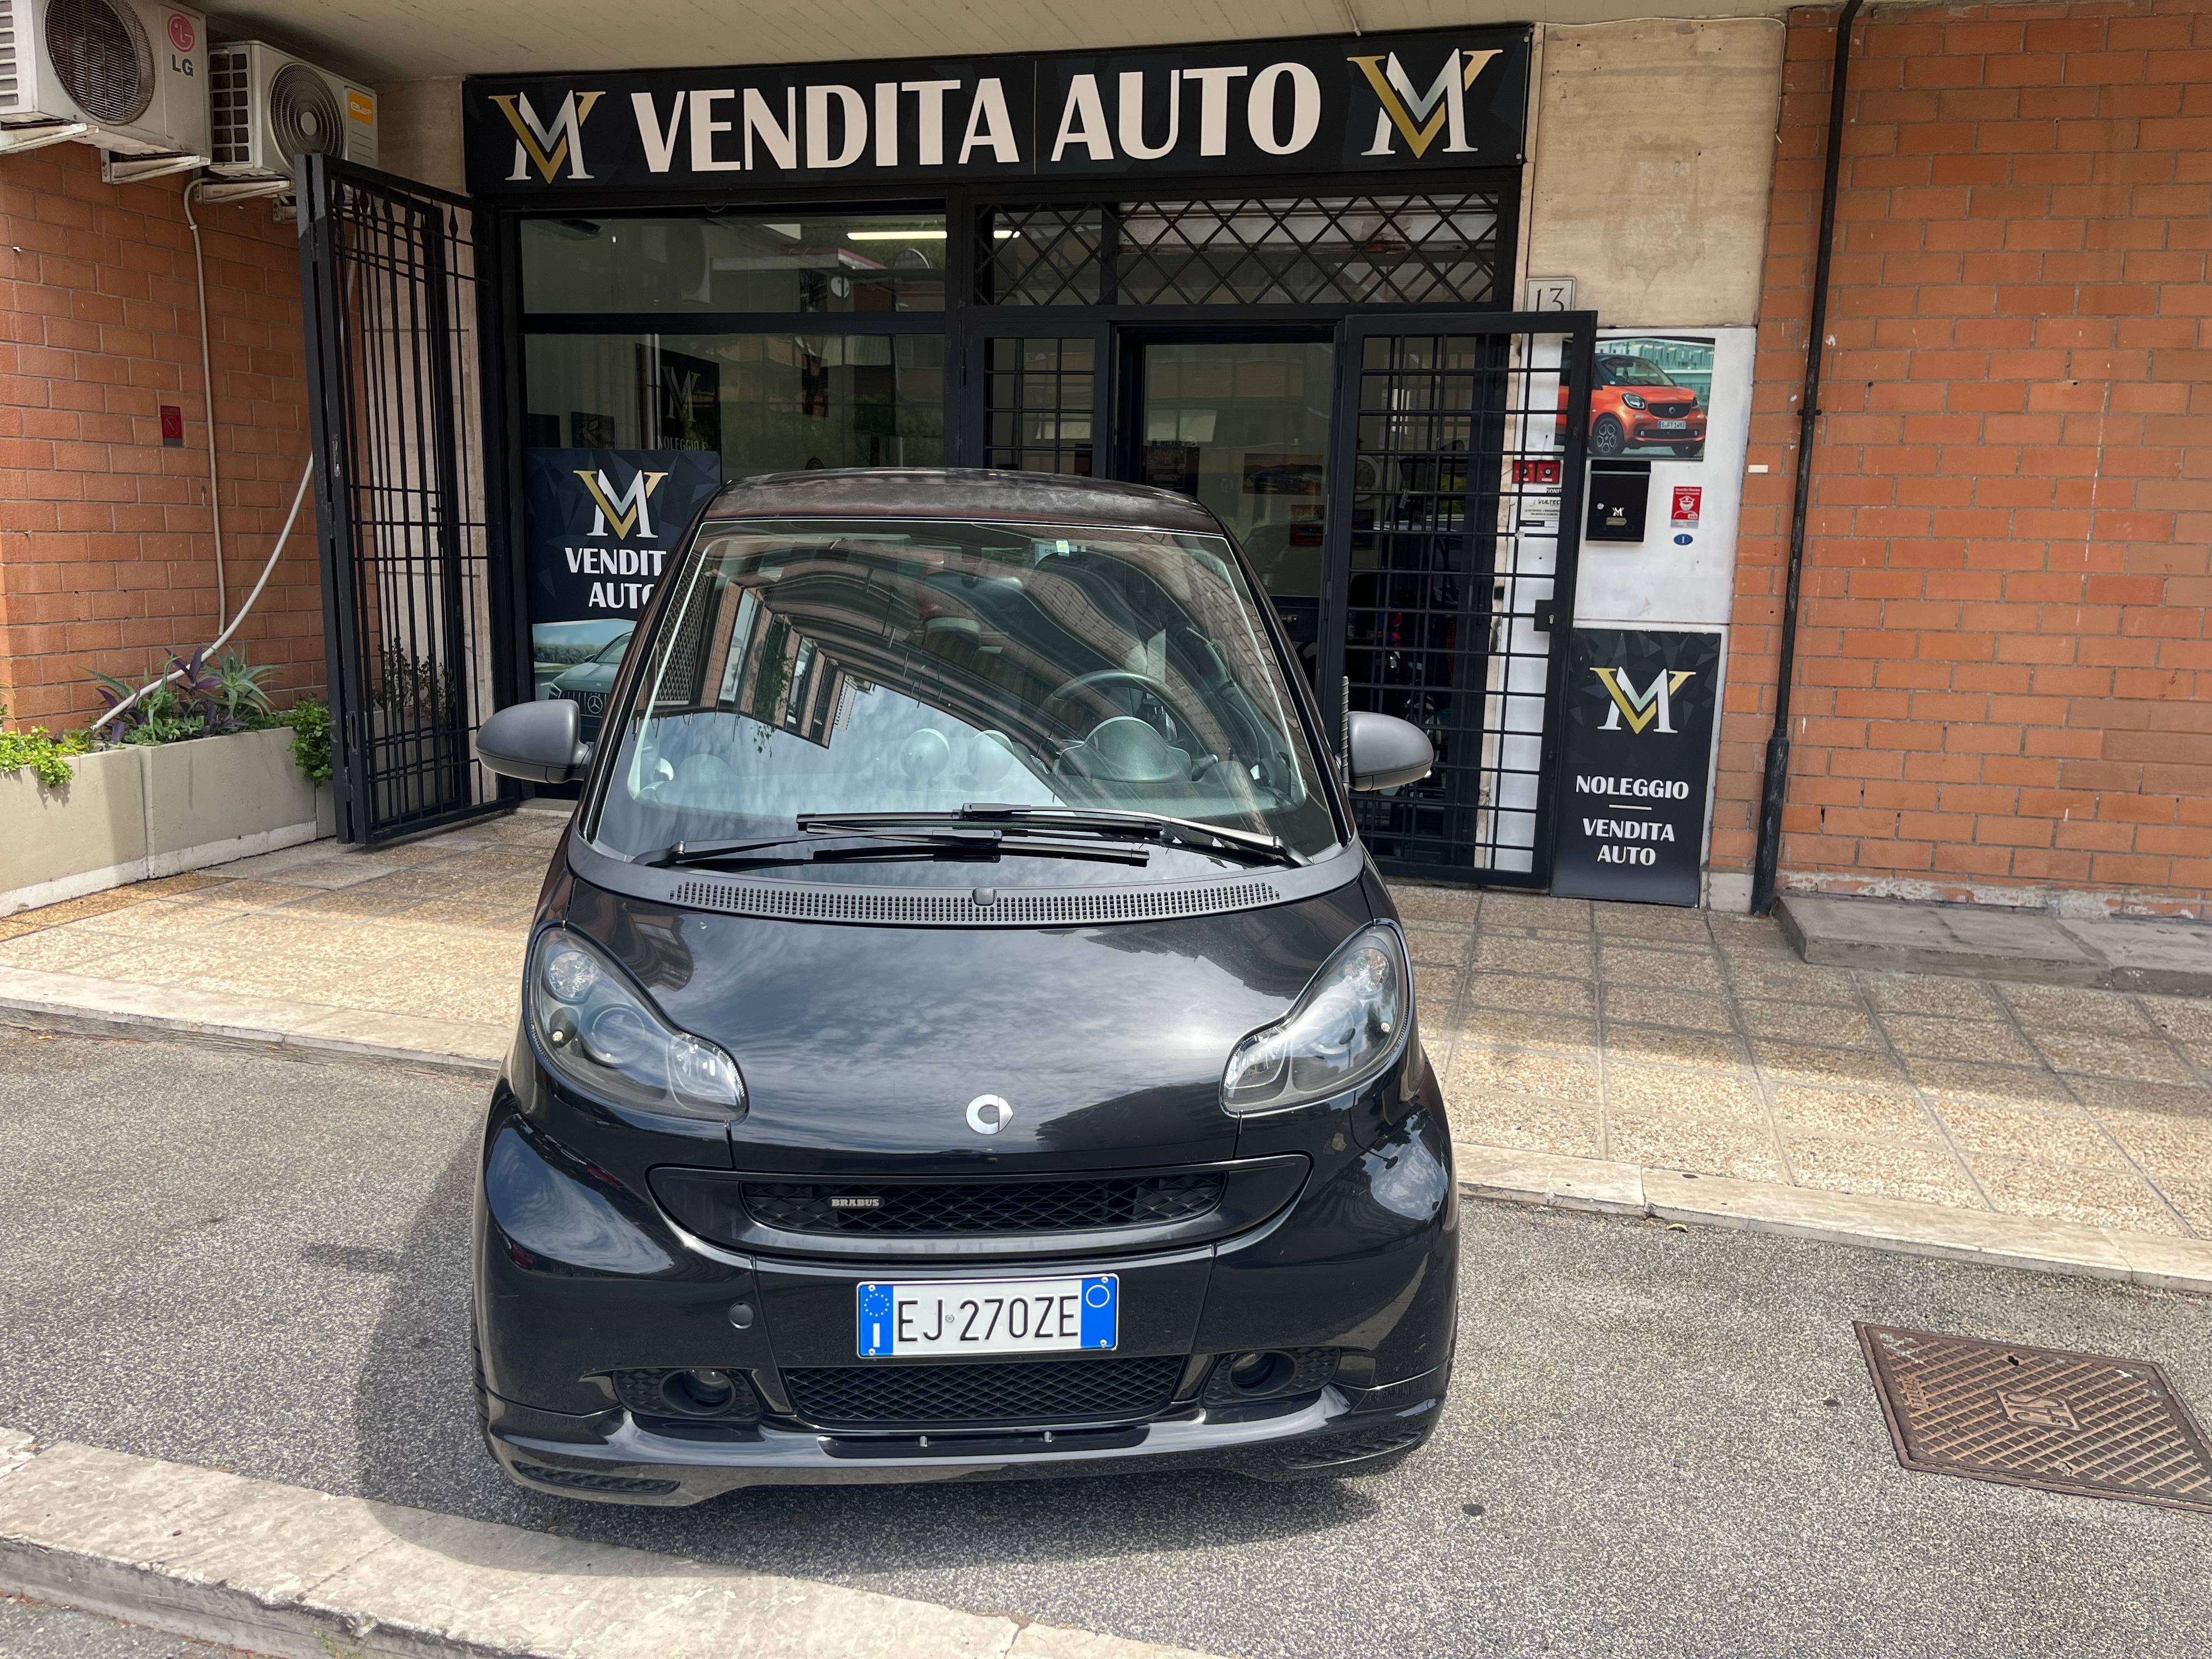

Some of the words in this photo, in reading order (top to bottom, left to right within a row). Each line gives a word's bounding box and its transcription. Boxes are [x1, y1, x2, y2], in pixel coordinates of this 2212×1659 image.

[172, 54, 194, 77] LG
[631, 78, 1019, 173] VENDITA
[1051, 63, 1321, 162] AUTO
[1537, 287, 1564, 312] 13
[565, 547, 667, 576] VENDIT
[1576, 775, 1689, 799] NOLEGGIO
[1583, 817, 1675, 842] VENDITA
[1596, 845, 1656, 866] AUTO
[831, 1199, 879, 1207] BRABUS
[898, 1299, 943, 1342] EJ
[959, 1295, 1079, 1341] 270ZE
